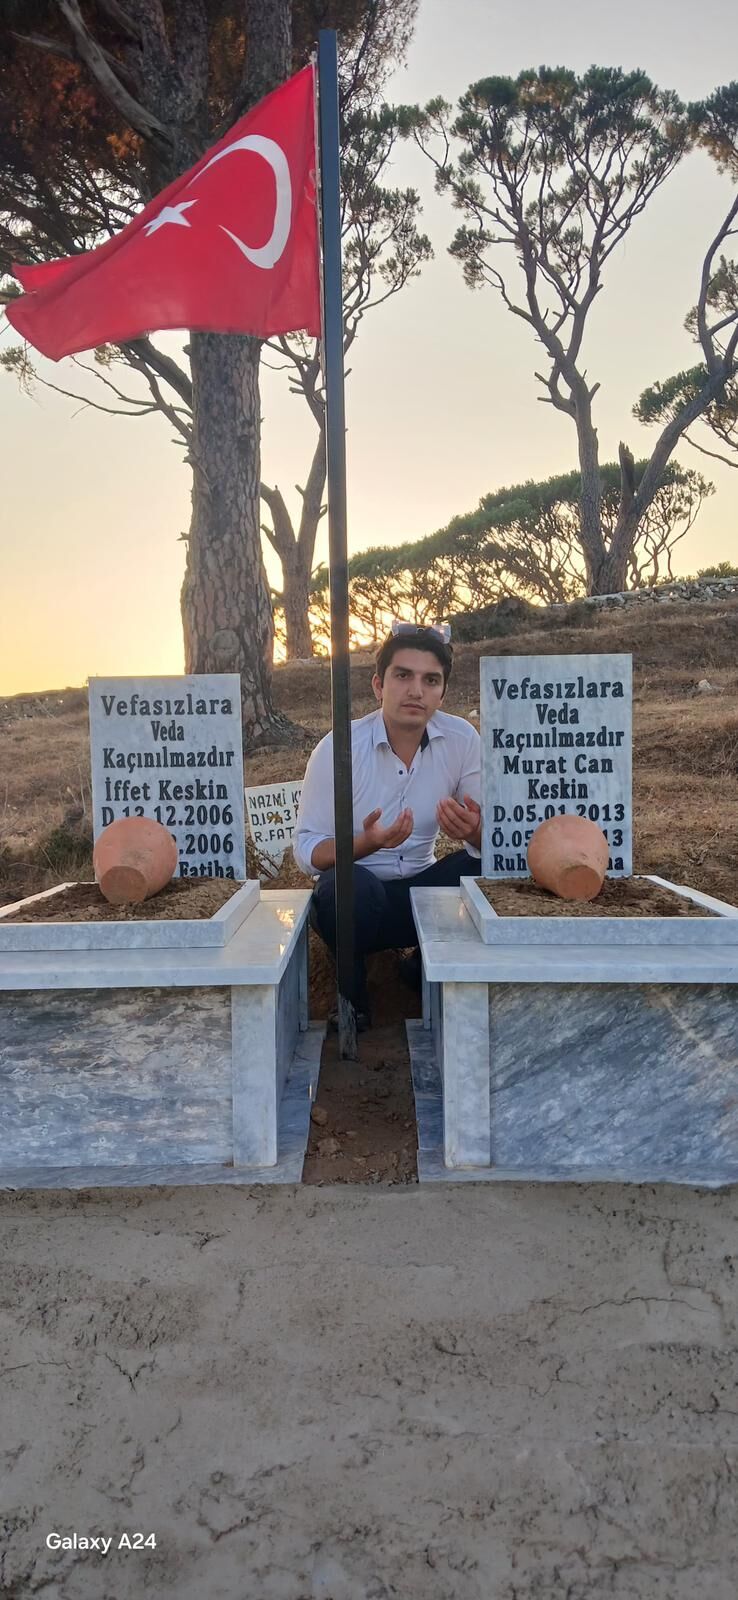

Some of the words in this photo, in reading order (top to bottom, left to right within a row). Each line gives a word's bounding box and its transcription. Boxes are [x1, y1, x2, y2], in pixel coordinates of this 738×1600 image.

[492, 676, 625, 700] Vefasızlara
[101, 693, 233, 716] Vefasızlara
[536, 702, 580, 725] Veda
[151, 720, 185, 742] Veda
[492, 726, 625, 753] Kaçınılmazdır
[102, 745, 235, 774] Kaçınılmazdır
[503, 755, 567, 775] Murat
[574, 754, 614, 774] Can
[105, 777, 151, 801] İffet
[158, 779, 228, 801] Keskin
[528, 778, 589, 800] Keskin
[493, 803, 625, 823] D.05.012013
[254, 826, 295, 843] R.FAT
[178, 860, 235, 880] Fatiha
[493, 854, 528, 872] Ruh
